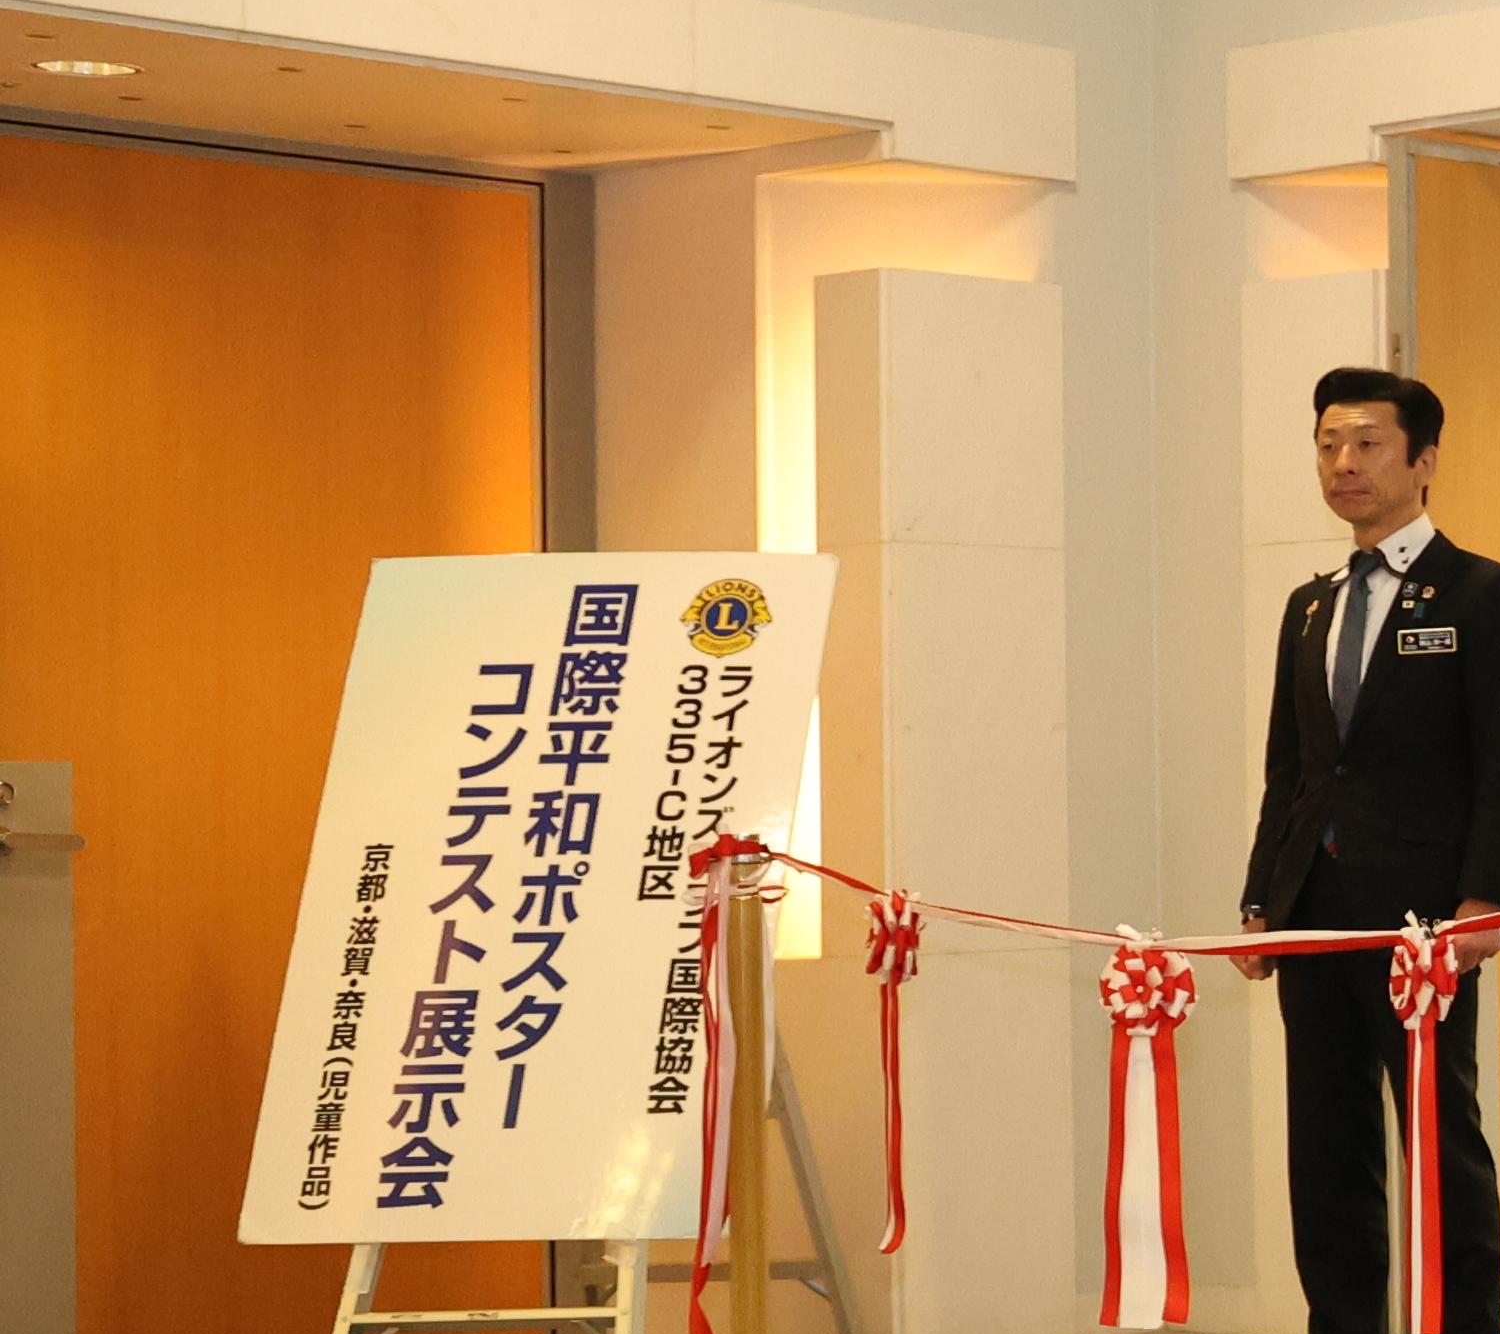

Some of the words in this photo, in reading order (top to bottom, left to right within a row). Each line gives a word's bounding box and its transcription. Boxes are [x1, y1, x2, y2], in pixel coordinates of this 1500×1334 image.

[376, 663, 536, 1210] コンテスト展示会
[495, 583, 640, 1130] 国際平和ポスター
[646, 665, 754, 1115] ライオンズ国際協会
